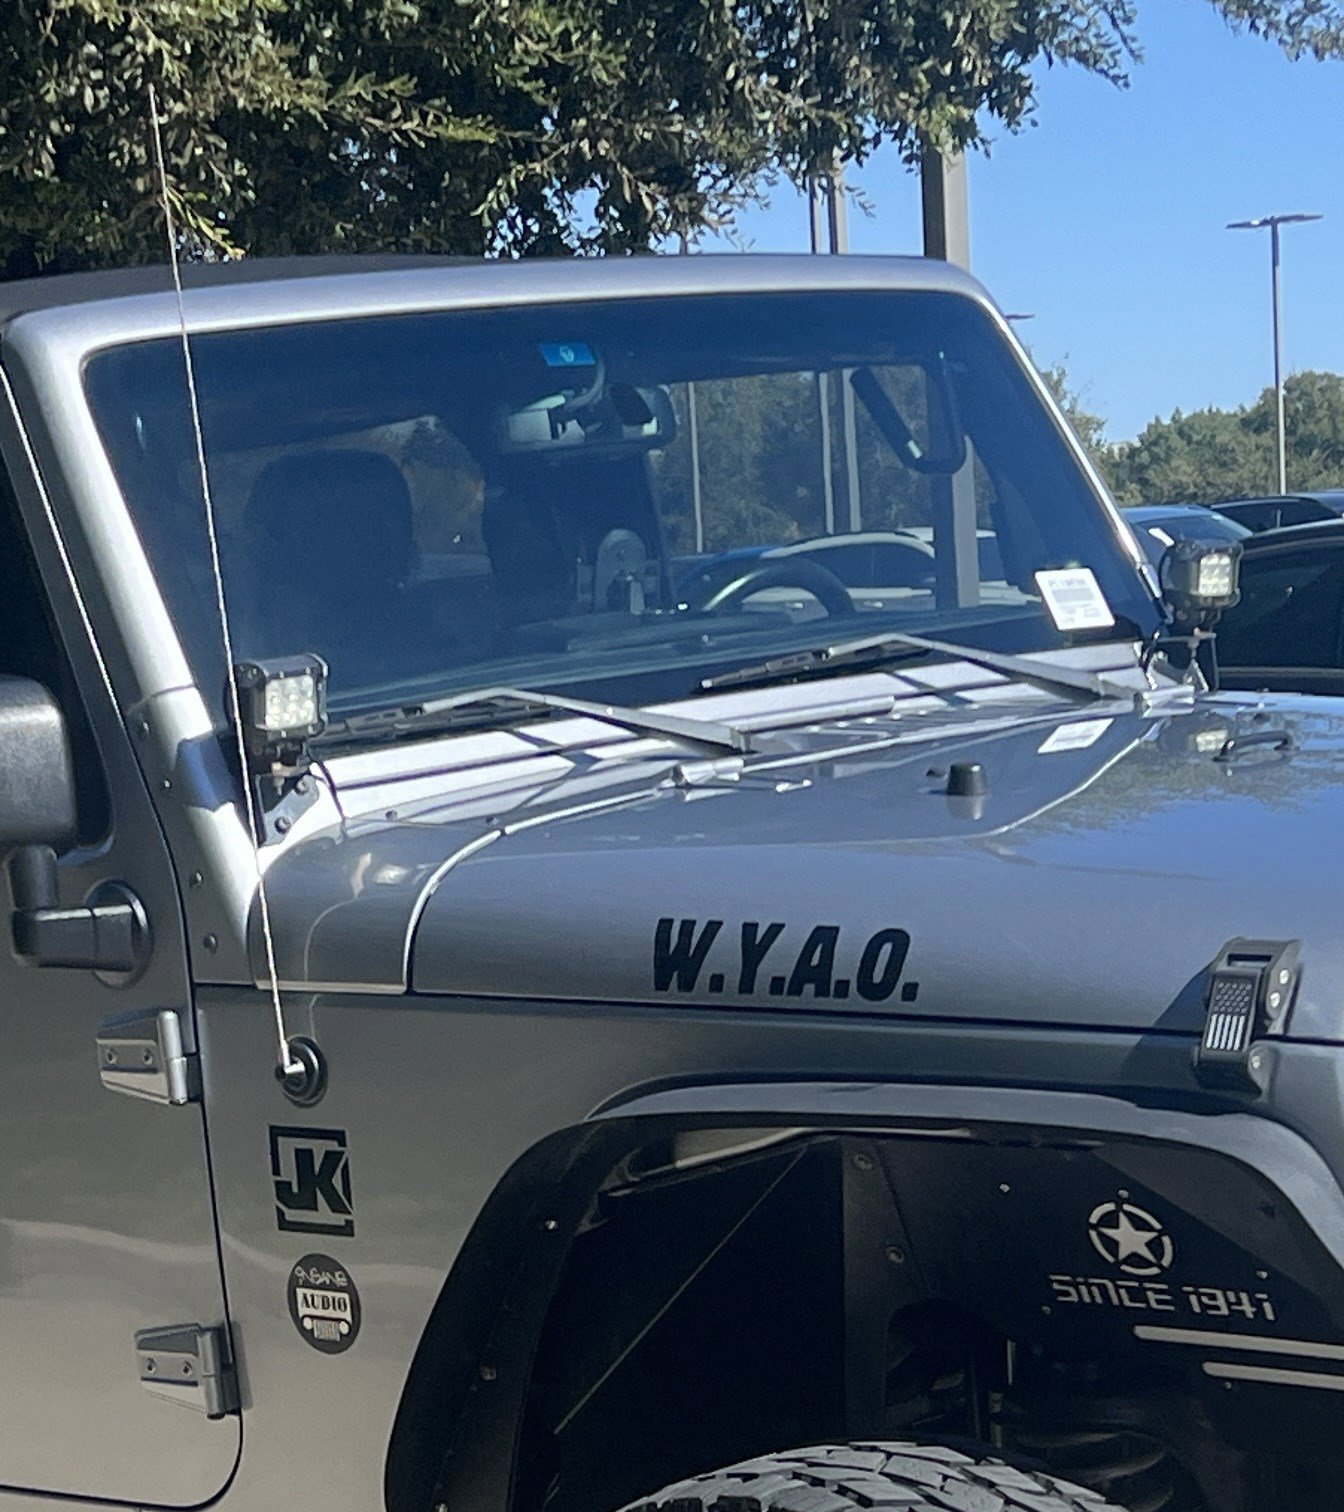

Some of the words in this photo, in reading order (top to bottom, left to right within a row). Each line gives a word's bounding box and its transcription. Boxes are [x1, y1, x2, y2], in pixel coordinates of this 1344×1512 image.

[654, 918, 919, 1001] W.Y.A.O.
[273, 1147, 353, 1215] JK
[301, 1292, 348, 1313] AUDIO
[1049, 1274, 1175, 1312] SINCE
[1182, 1285, 1275, 1321] 1941
